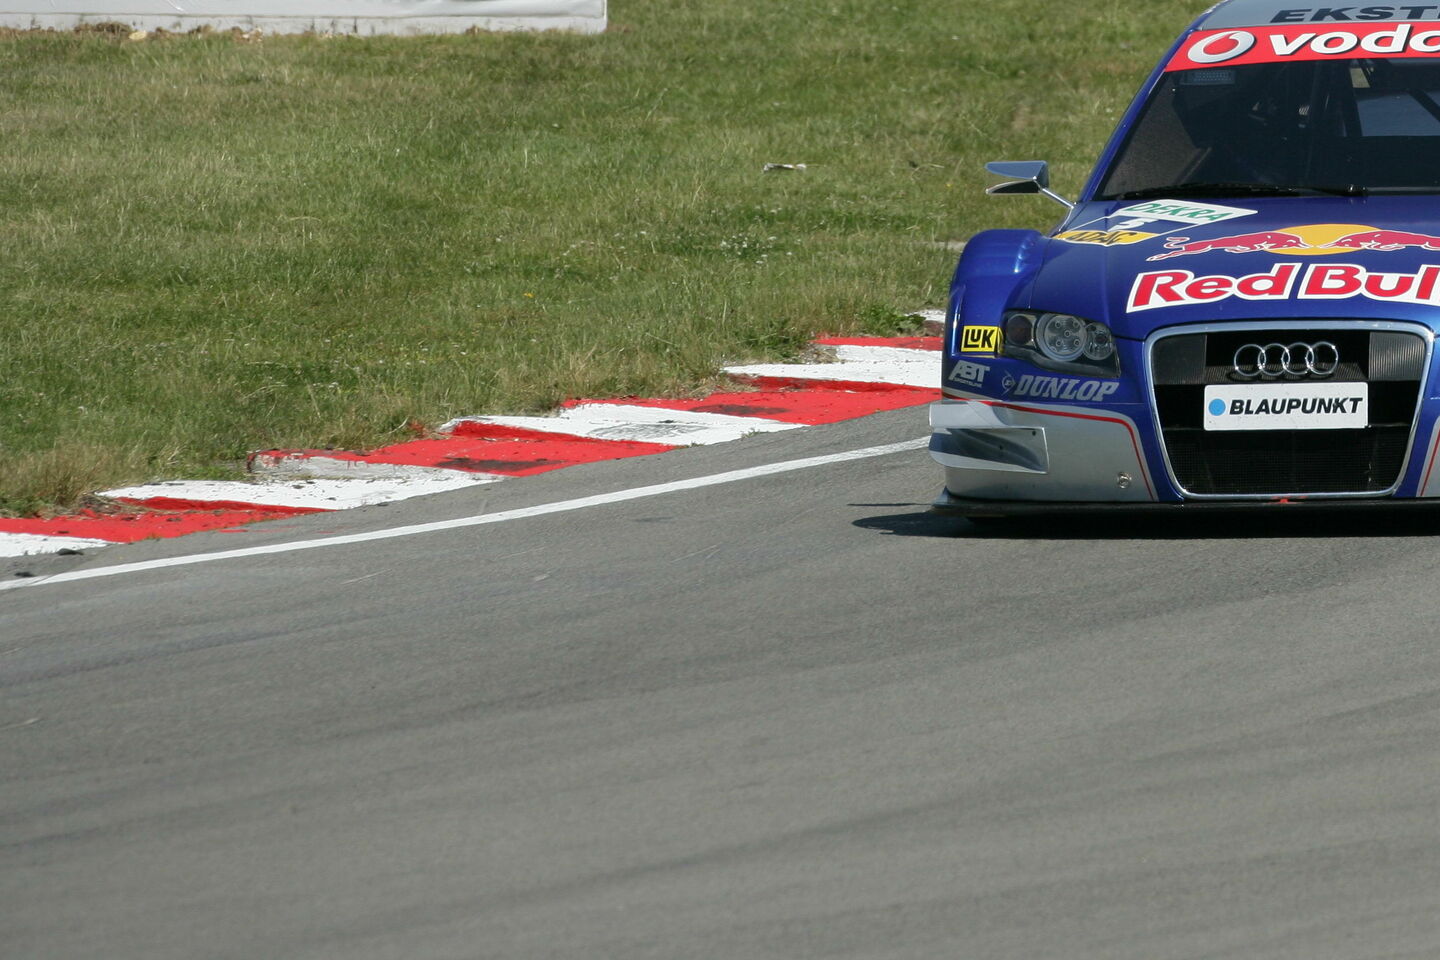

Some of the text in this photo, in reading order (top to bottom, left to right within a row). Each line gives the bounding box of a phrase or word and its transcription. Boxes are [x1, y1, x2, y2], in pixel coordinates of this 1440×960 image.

[1122, 200, 1234, 222] DEKRA
[1125, 263, 1302, 314] Red
[948, 359, 991, 383] ABT
[1013, 374, 1120, 402] DUNLOP
[1229, 396, 1363, 415] BLAUPUNKT
